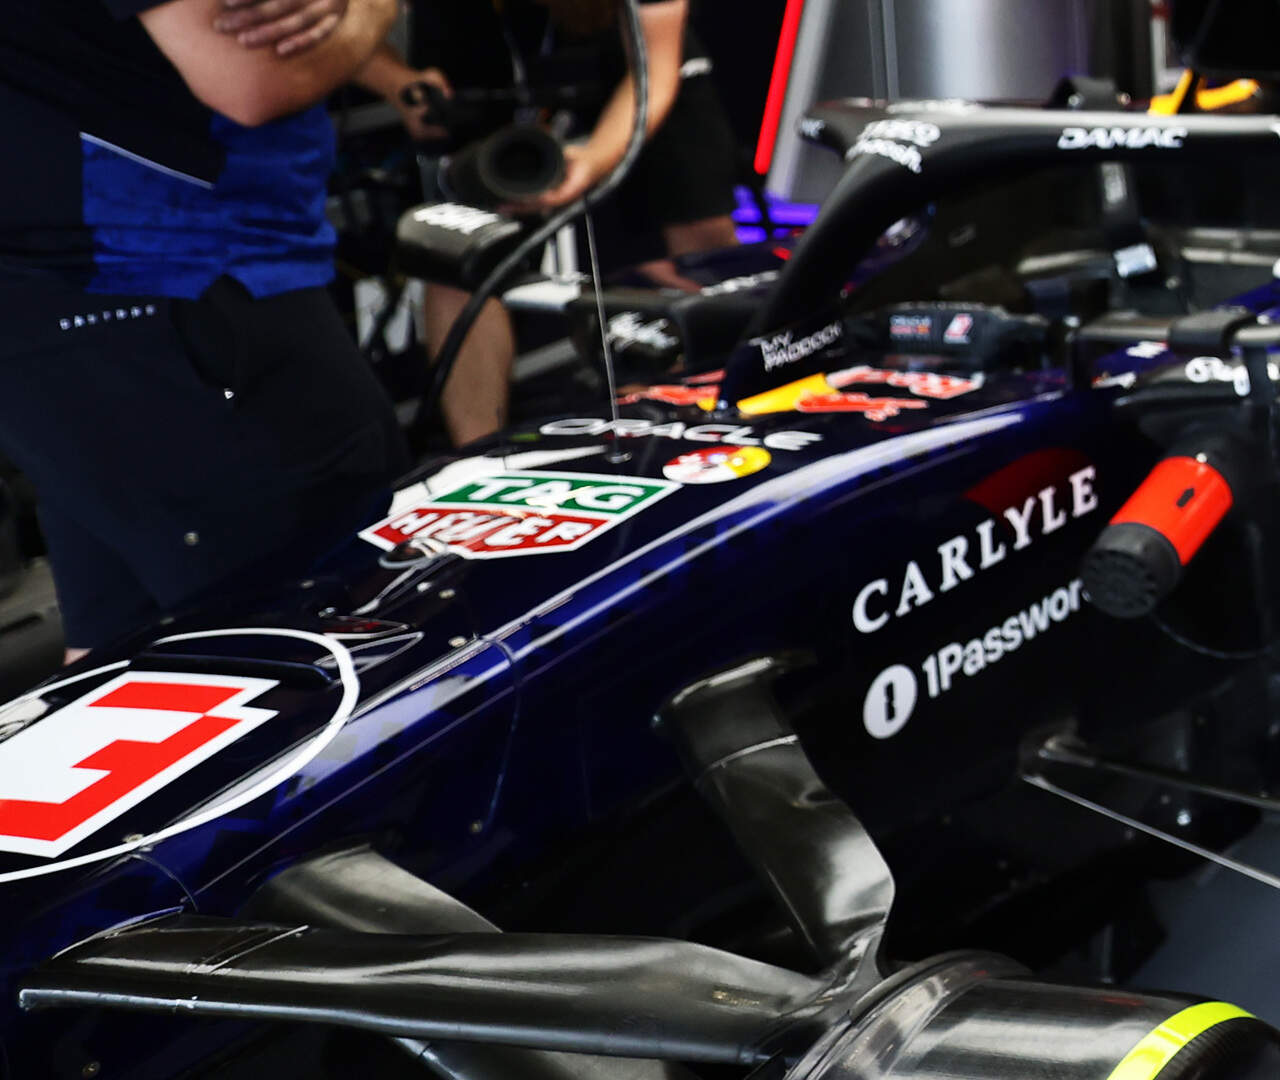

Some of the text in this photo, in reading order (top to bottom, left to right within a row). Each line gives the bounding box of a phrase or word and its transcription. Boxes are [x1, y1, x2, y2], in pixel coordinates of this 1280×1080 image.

[1057, 127, 1188, 150] DAMAC
[540, 418, 824, 451] ORACLE
[468, 477, 646, 508] TAG
[853, 466, 1098, 633] CARLYLE
[922, 578, 1091, 698] 1Passwor
